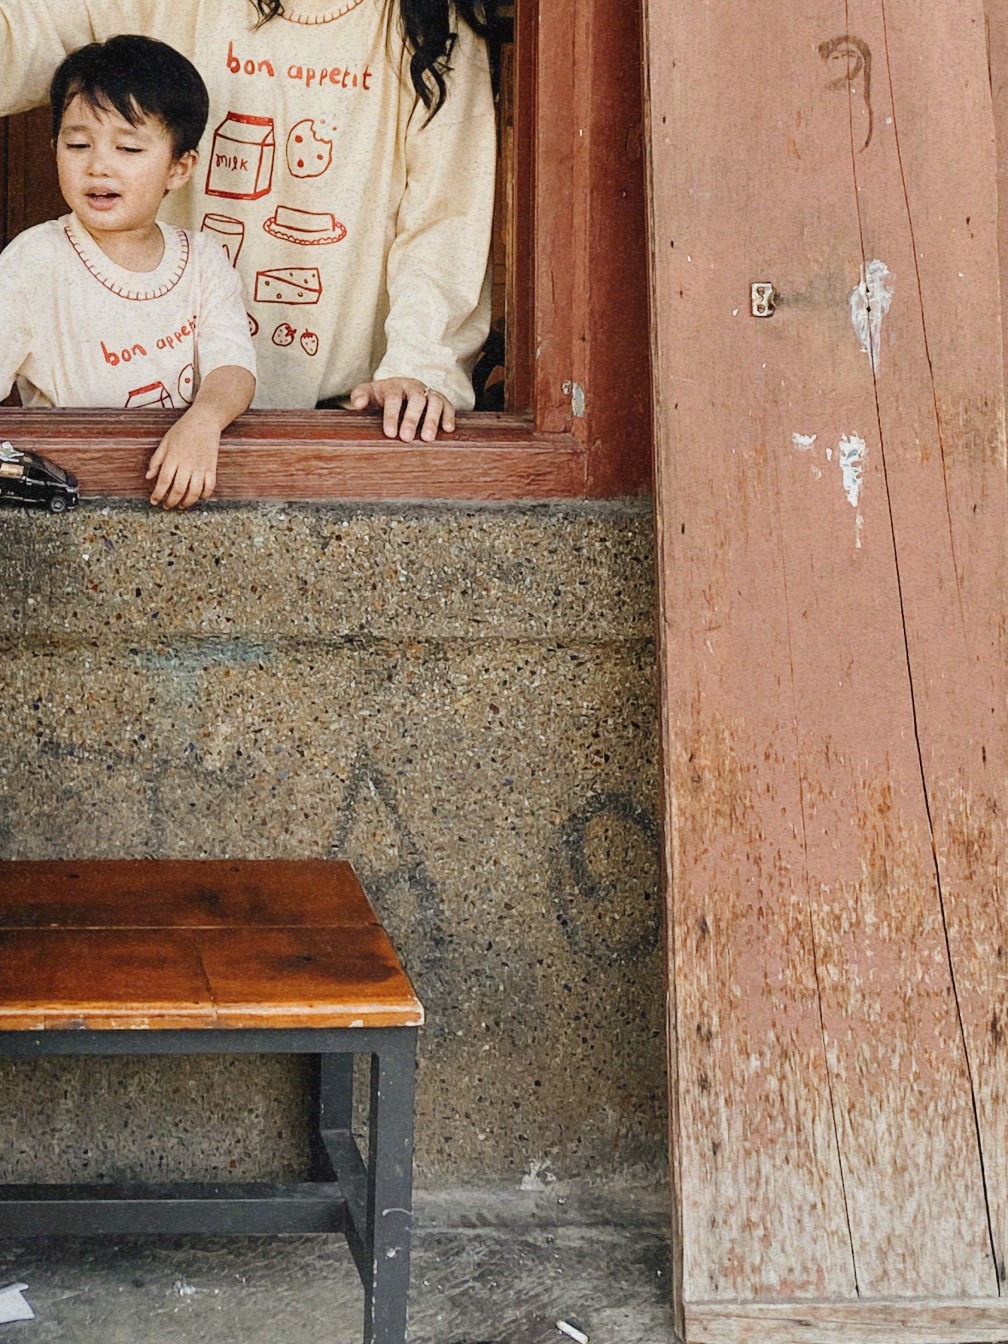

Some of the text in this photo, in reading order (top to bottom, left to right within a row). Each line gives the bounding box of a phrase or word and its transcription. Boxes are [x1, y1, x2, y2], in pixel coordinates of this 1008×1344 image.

[226, 40, 373, 91] bon appetit
[101, 341, 148, 367] bon
